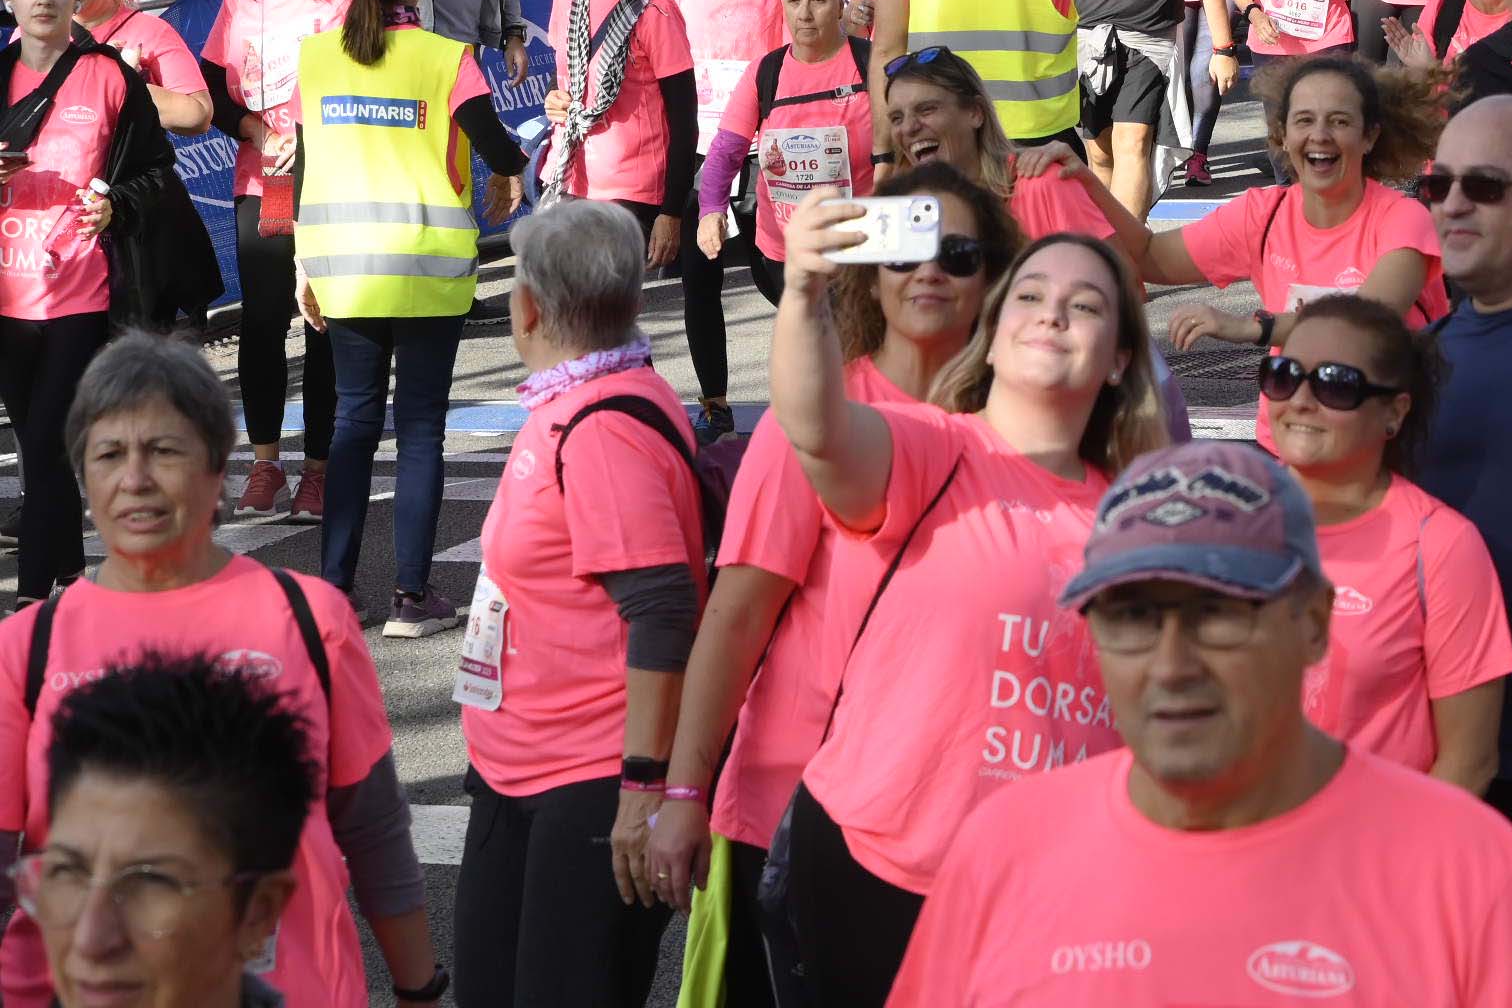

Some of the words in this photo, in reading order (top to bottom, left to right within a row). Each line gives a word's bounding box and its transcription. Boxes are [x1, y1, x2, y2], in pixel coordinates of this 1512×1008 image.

[1286, 0, 1307, 11] 016
[322, 103, 414, 121] VOLUNTARIS
[785, 141, 819, 150] ASTURIANA
[788, 159, 819, 171] 016
[796, 173, 814, 181] 1720
[998, 613, 1050, 658] TU
[990, 670, 1119, 729] DORSA
[1051, 938, 1152, 976] OYSHO
